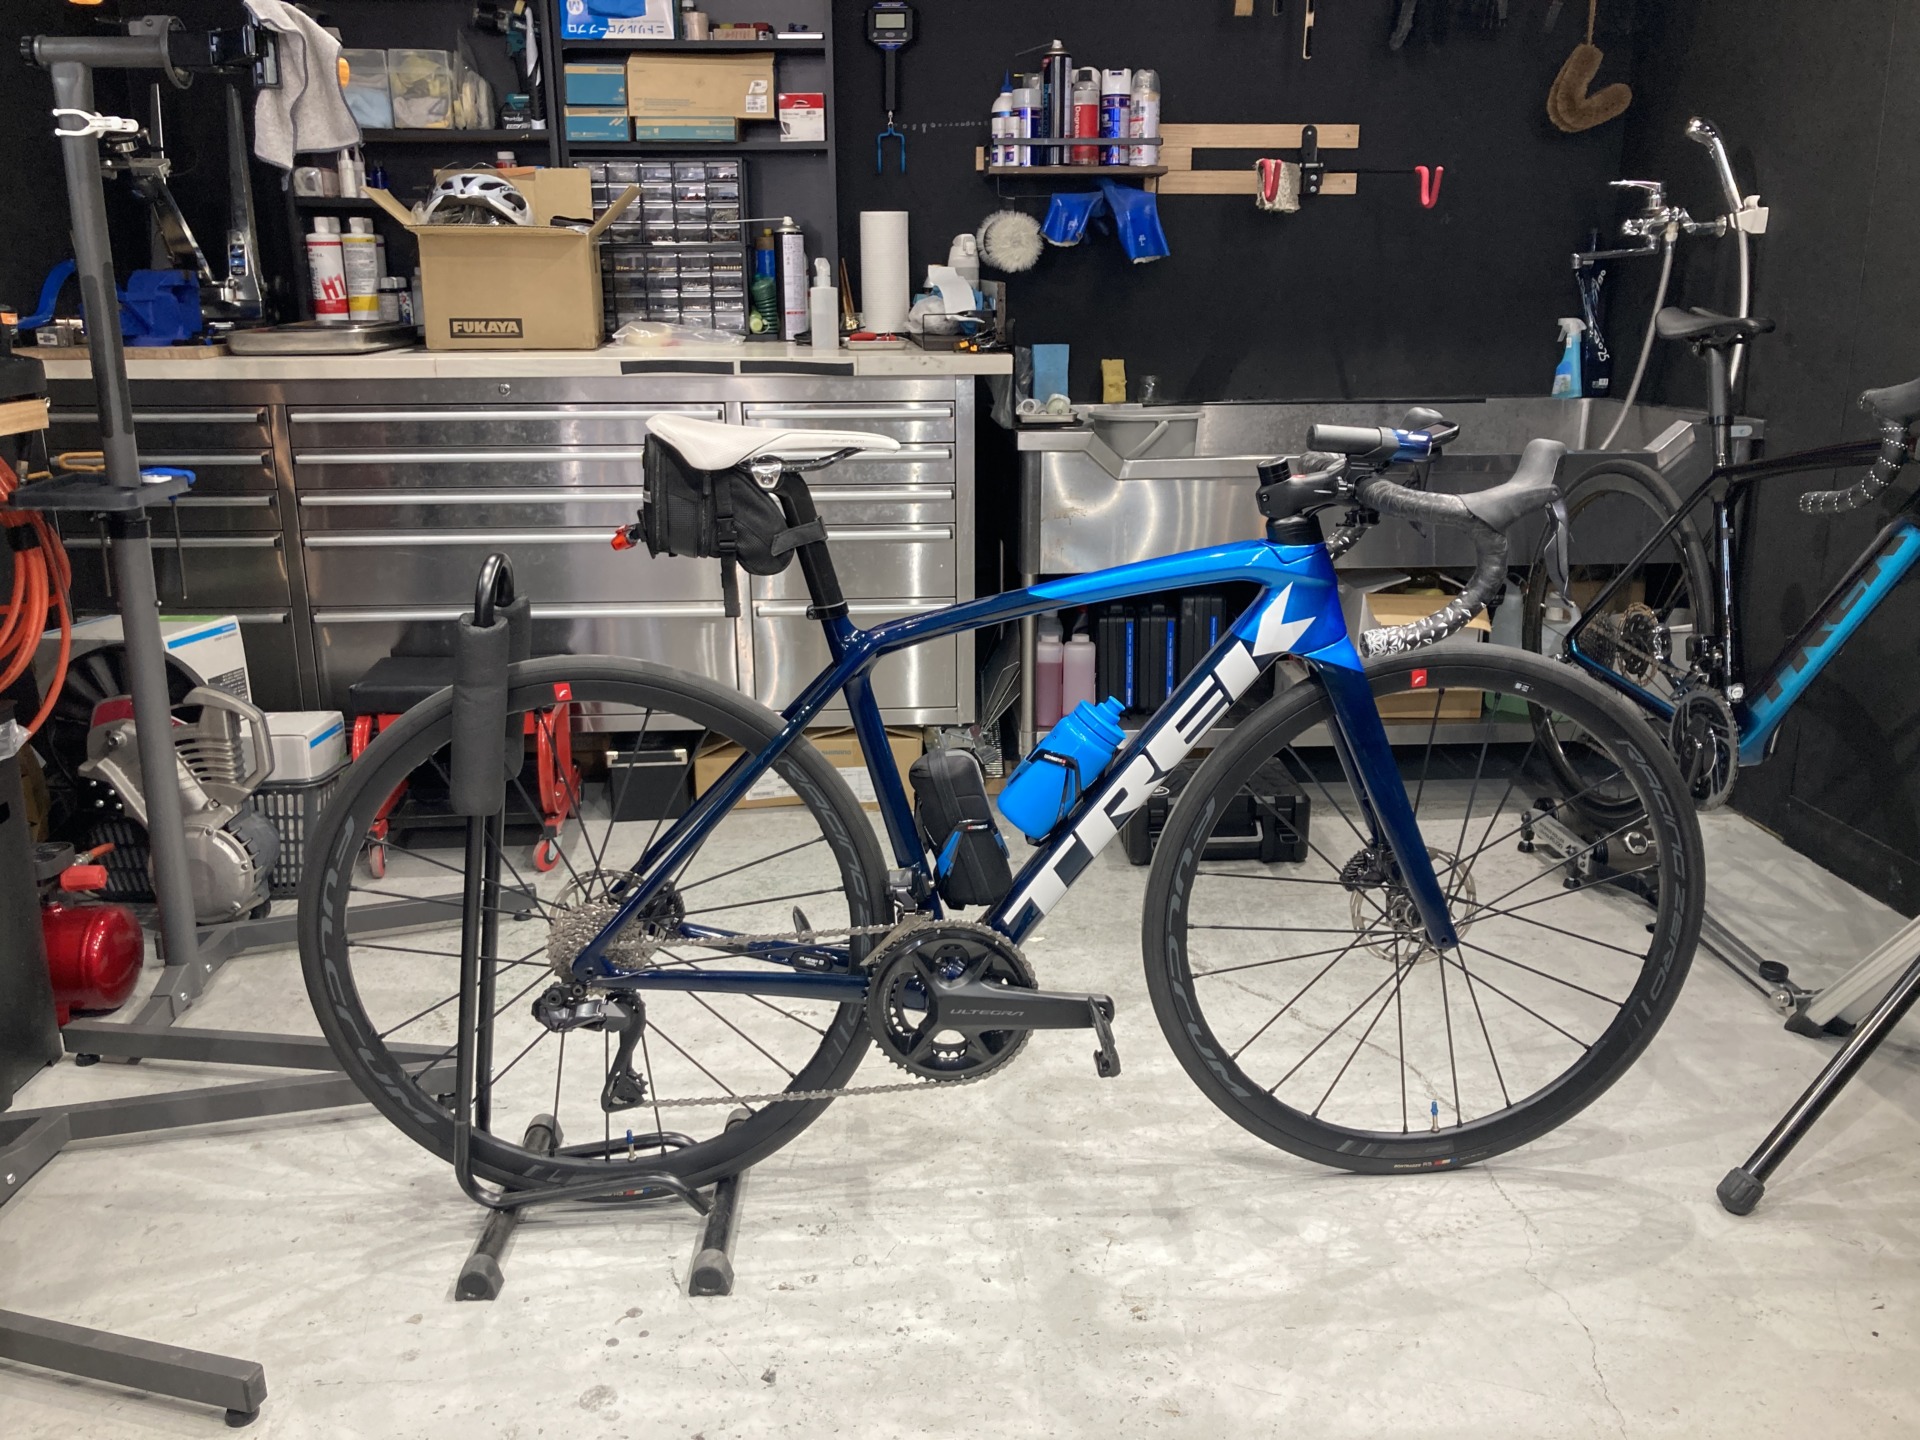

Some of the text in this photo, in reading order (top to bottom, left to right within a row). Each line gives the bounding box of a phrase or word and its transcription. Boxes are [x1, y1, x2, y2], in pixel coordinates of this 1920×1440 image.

[452, 321, 520, 333] FUKAYA
[1003, 582, 1317, 925] TREK
[776, 758, 868, 901] RACING
[1614, 739, 1686, 1001] RACING ZERO
[950, 1008, 1024, 1017] ULTEGRA
